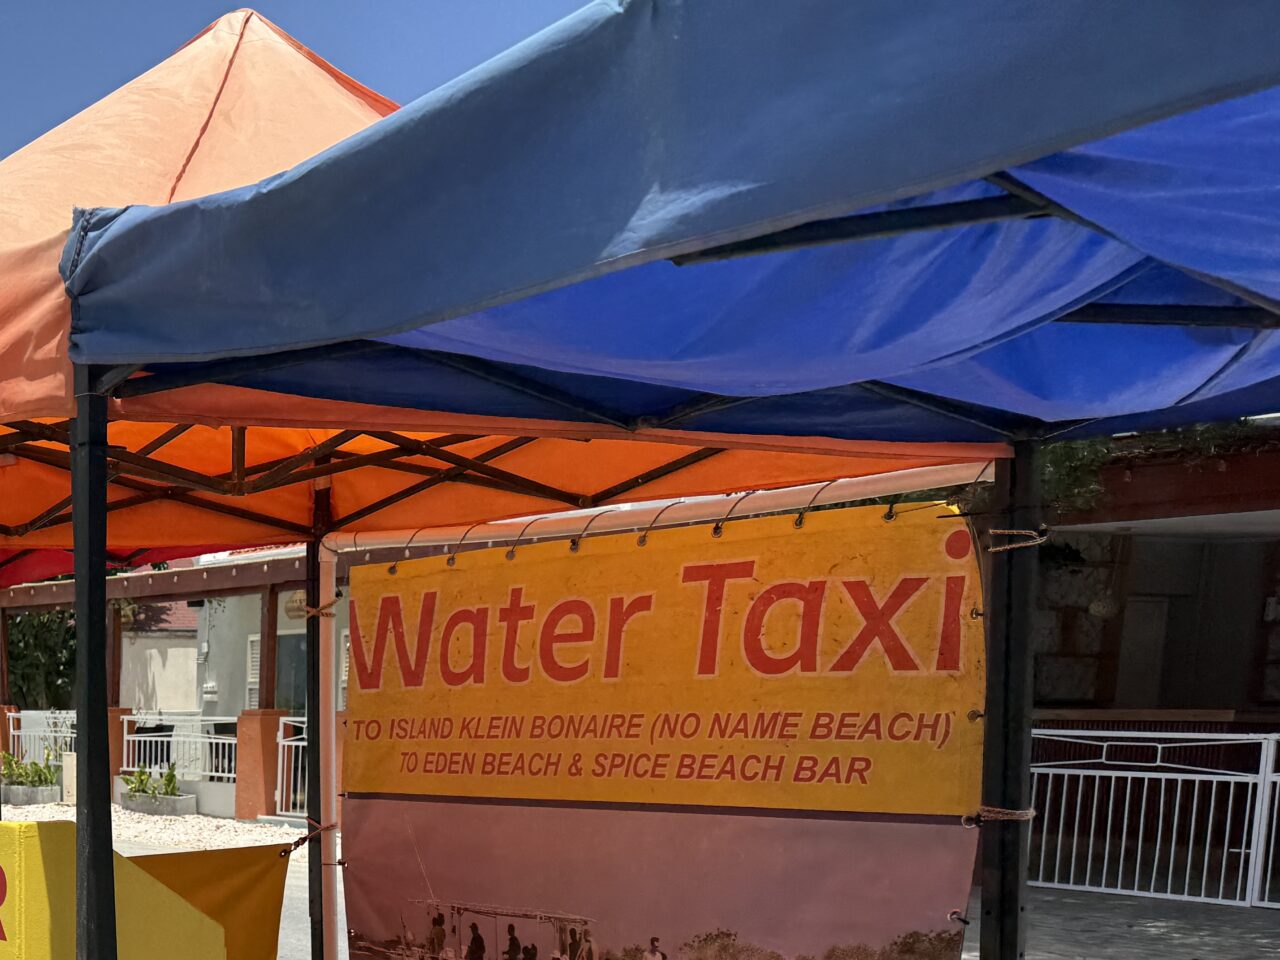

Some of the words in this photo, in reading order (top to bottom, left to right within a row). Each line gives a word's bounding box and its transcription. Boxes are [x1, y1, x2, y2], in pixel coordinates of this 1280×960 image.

[350, 587, 653, 690] Water
[682, 530, 972, 676] Taxi
[353, 720, 381, 741] TO
[389, 717, 454, 740] ISLAND
[459, 715, 524, 740] KLEIN
[529, 713, 645, 740] BONAIRE
[650, 712, 701, 746] (NO
[708, 711, 803, 740] NAME
[809, 711, 952, 749] BEACH)
[400, 751, 418, 773] TO
[423, 752, 477, 775] EDEN
[481, 752, 562, 777] BEACH
[568, 752, 583, 778] &
[591, 752, 670, 779] SPICE
[675, 753, 785, 782] BEACH
[792, 754, 872, 785] BAR
